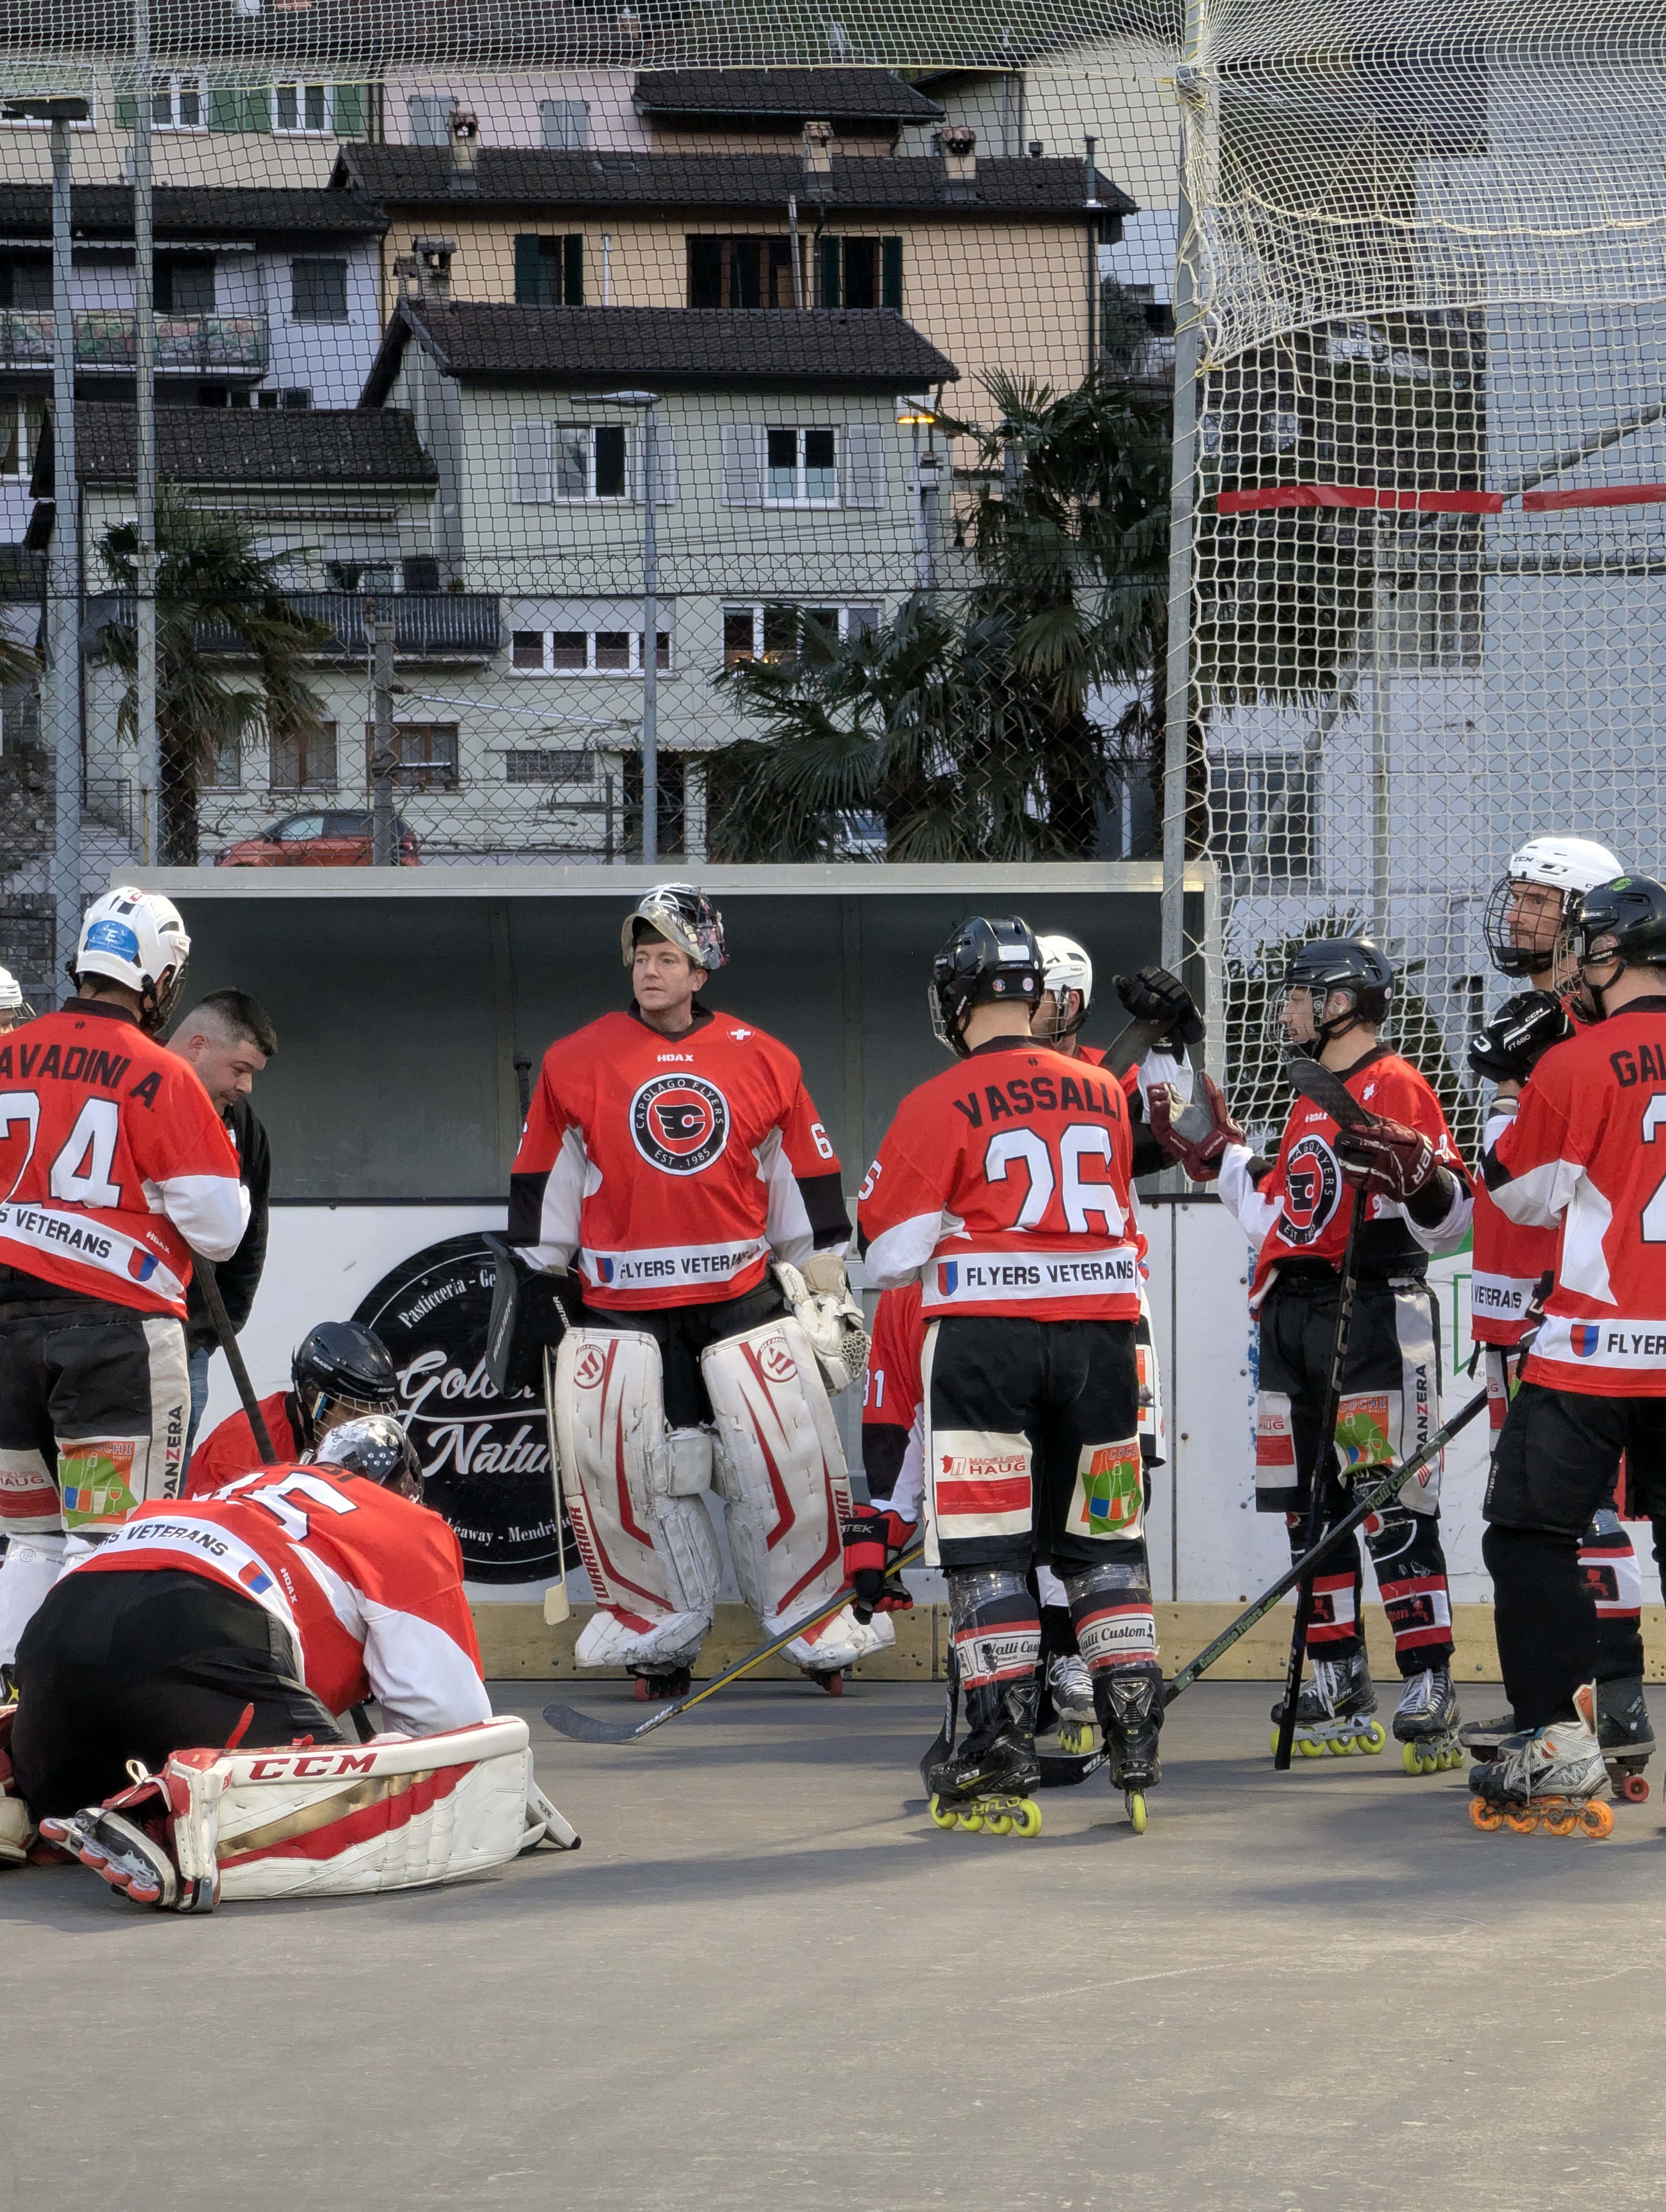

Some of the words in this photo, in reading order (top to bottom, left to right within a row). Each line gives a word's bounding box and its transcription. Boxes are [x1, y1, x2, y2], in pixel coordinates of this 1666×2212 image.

[1525, 1007, 1543, 1022] CCM
[1508, 1034, 1531, 1051] FT680
[657, 1054, 694, 1062] HOAX
[636, 1079, 685, 1128] CAPOLAGO
[692, 1082, 724, 1124] FLYERS
[953, 1077, 1122, 1129] VASSALLI
[654, 1149, 675, 1165] EST
[685, 1148, 710, 1167] 1985
[983, 1122, 1125, 1237] 26
[16, 1208, 112, 1259] VETERANS
[146, 1230, 171, 1254] HOAX
[620, 1261, 676, 1279] FLYERS
[967, 1266, 1040, 1286] FLYERS
[1047, 1260, 1134, 1283] VETERANS
[398, 1278, 467, 1330] Pasticceria
[1339, 1397, 1387, 1414] COCHI
[969, 1461, 1026, 1475] HAUG
[127, 1524, 229, 1557] VETERANS
[567, 1506, 610, 1599] WARRIOR
[280, 1567, 298, 1604] HOAX
[1101, 1625, 1146, 1641] Custom
[249, 1753, 378, 1780] CCM
